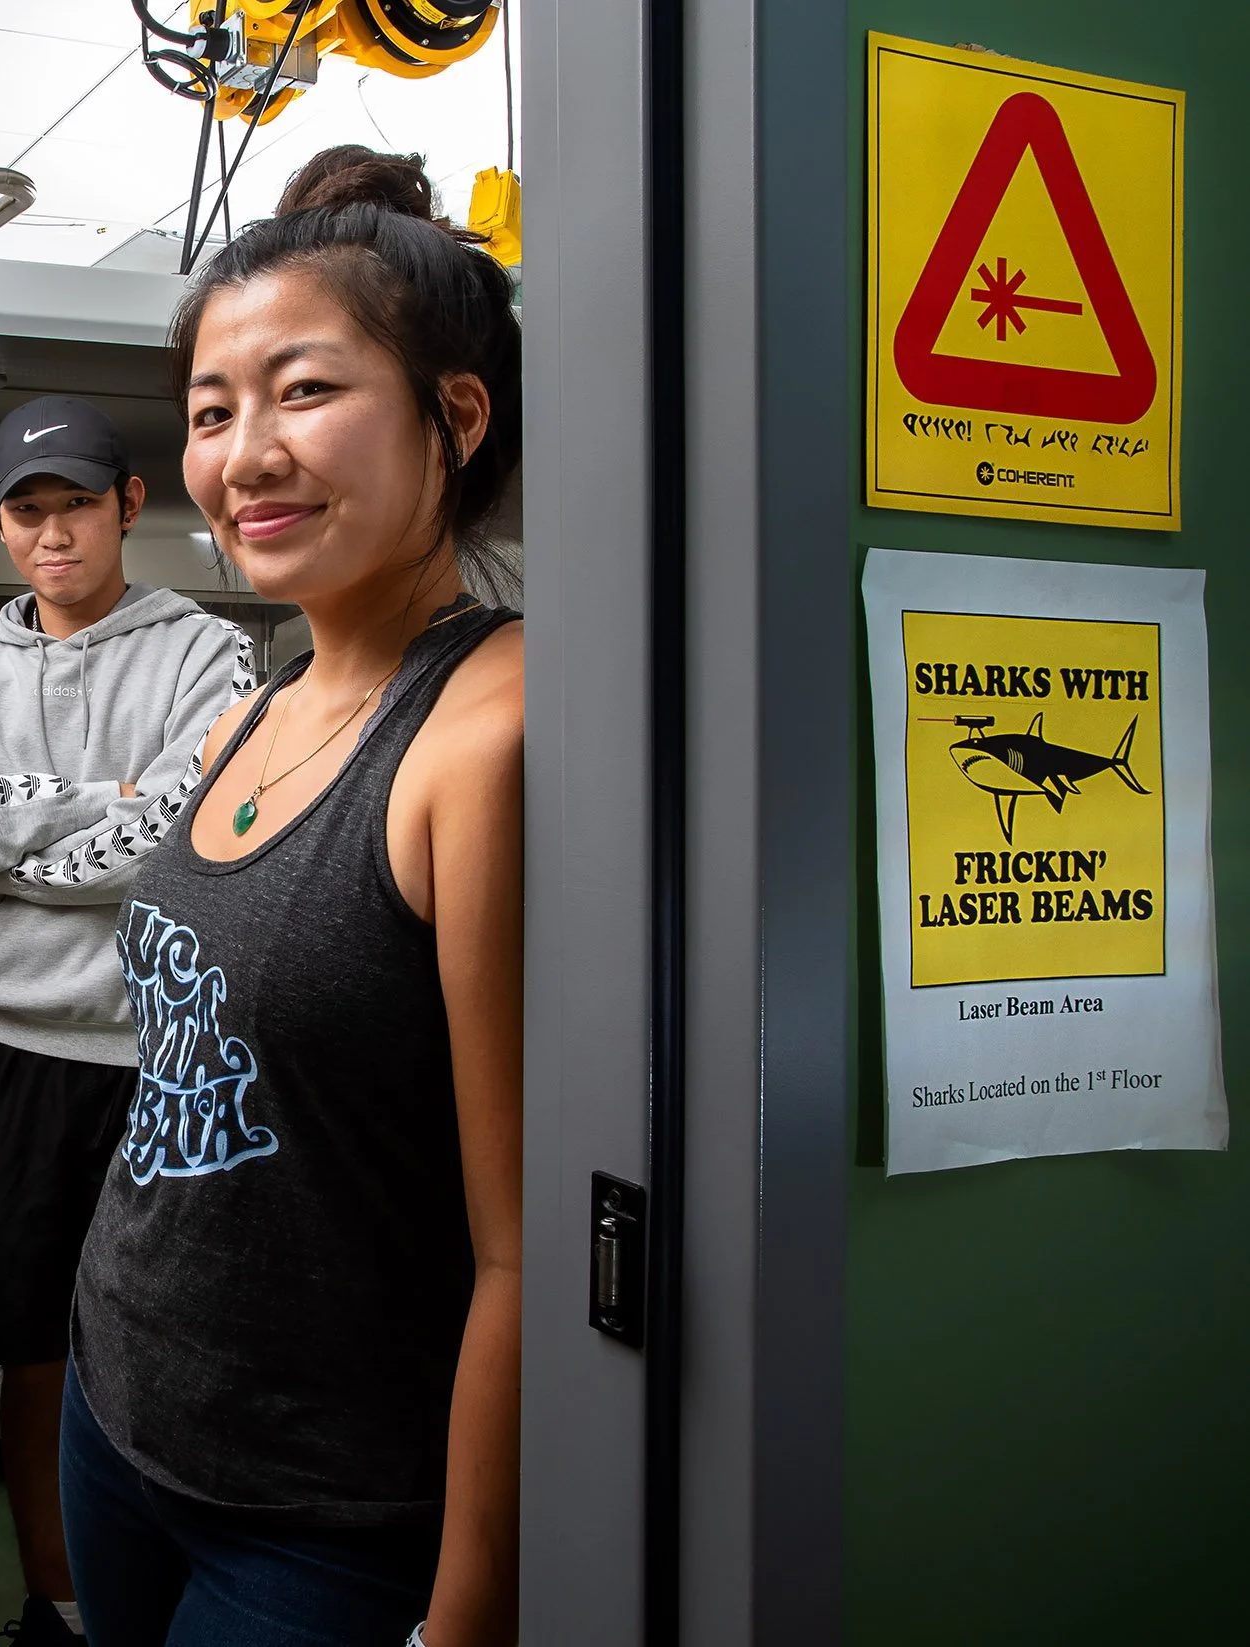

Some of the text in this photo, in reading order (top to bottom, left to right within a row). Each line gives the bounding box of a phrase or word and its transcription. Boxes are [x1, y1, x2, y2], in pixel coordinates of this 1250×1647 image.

[997, 467, 1075, 488] COHERENT
[915, 662, 1149, 701] SHARKS WITH
[919, 889, 1153, 928] LASER BEAMS
[958, 994, 1104, 1021] Laser Beam Area
[912, 1069, 1162, 1108] Sharks Located on the 1st Floor
